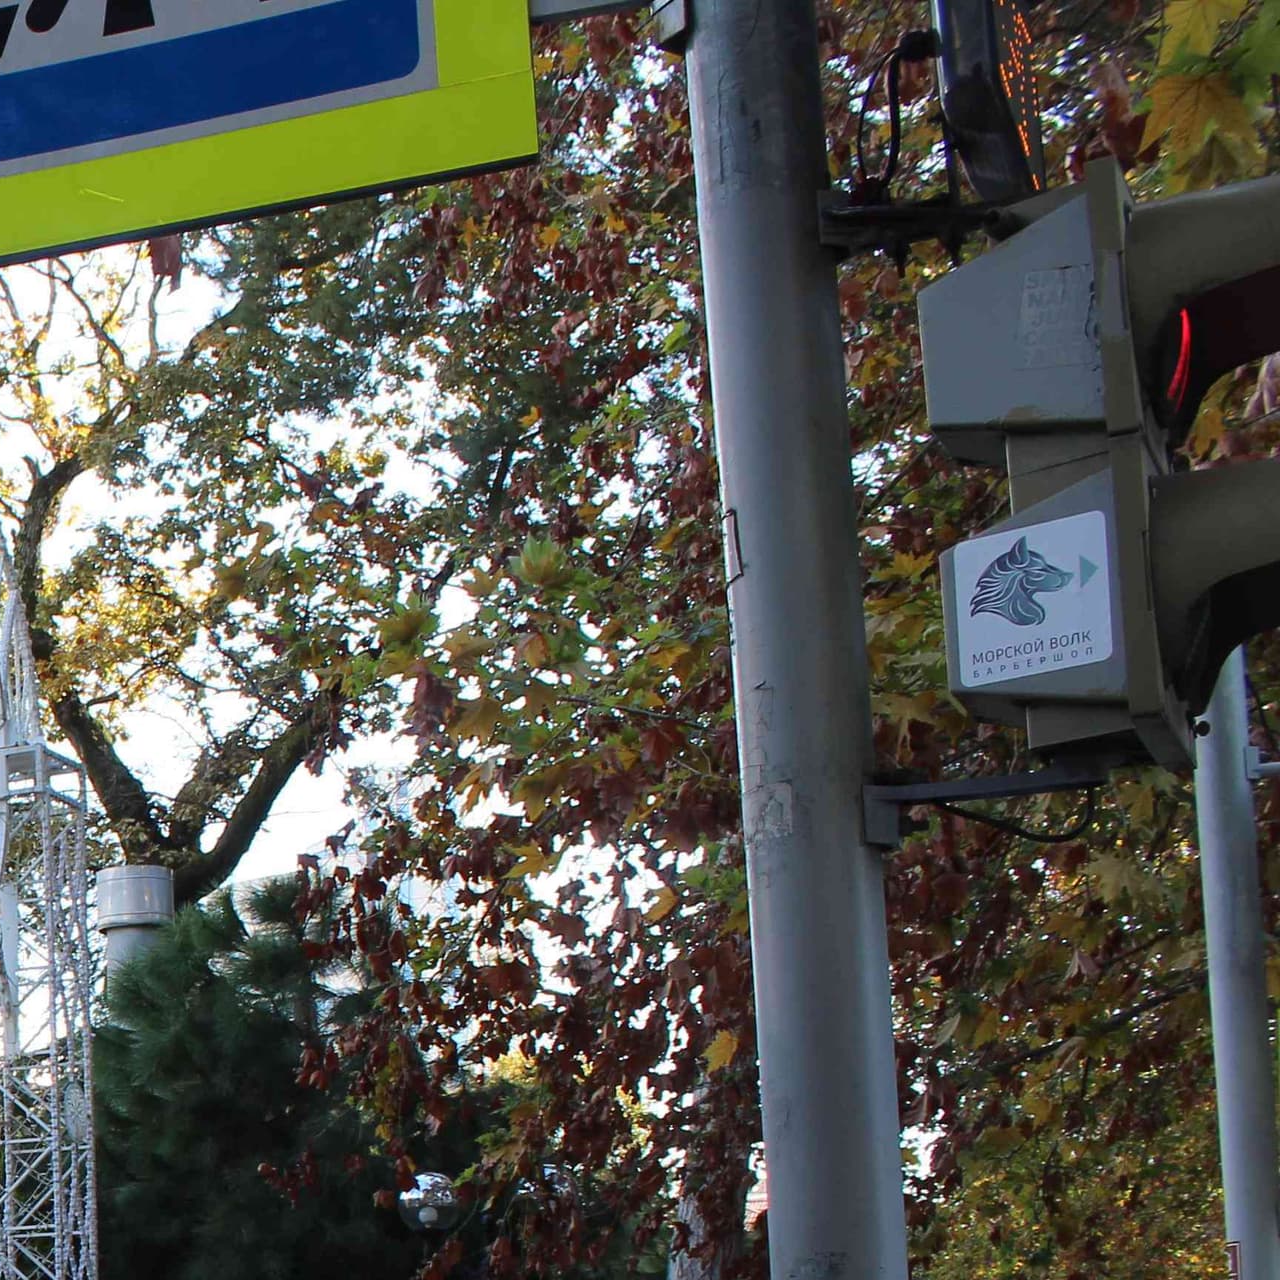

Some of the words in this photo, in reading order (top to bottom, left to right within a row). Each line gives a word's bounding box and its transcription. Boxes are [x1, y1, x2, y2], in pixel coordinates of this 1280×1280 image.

[972, 637, 1045, 665] МОРСКОЙ
[1049, 630, 1092, 650] ВОЛК
[972, 646, 1094, 679] БАРБЕРШОП
